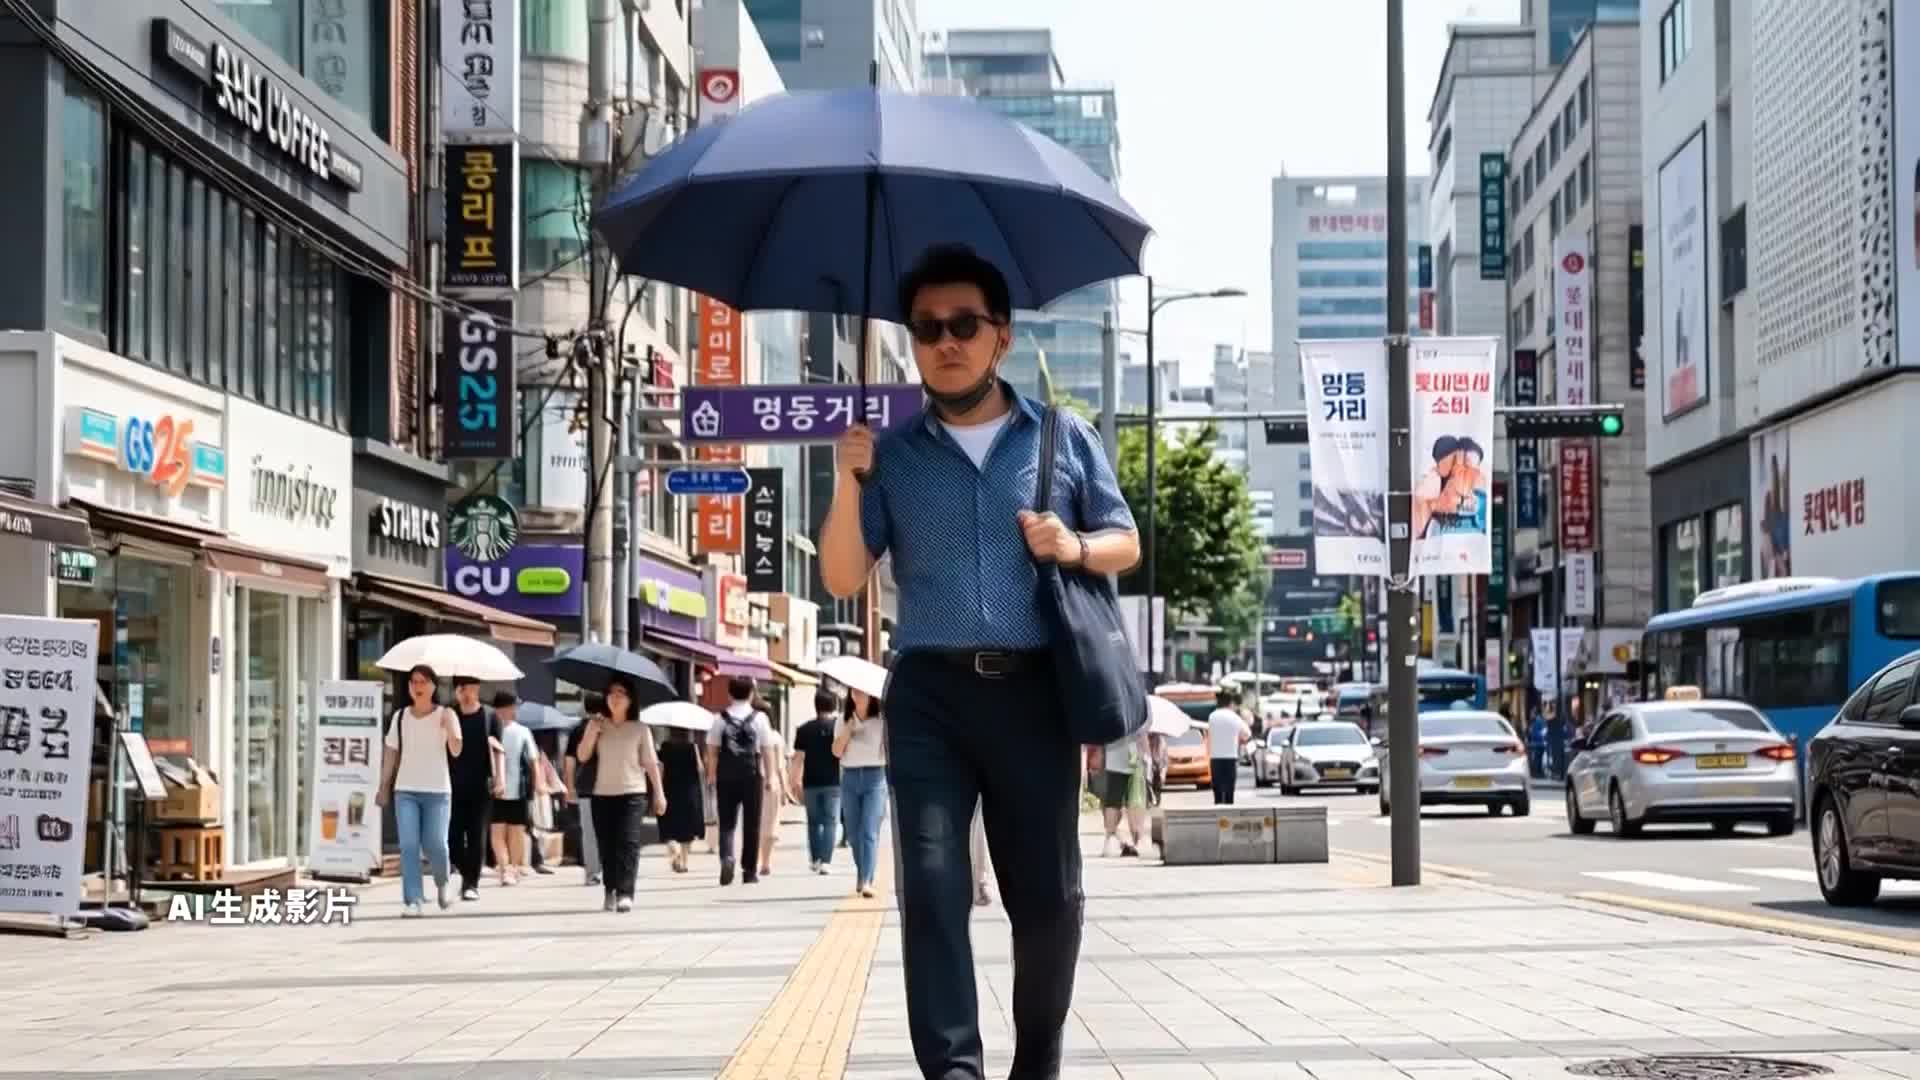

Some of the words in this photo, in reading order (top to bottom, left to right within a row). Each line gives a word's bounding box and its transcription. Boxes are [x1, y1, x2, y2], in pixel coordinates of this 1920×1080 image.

[266, 84, 330, 180] COFFEE
[459, 313, 498, 431] GS25
[752, 395, 890, 432] 명동거리
[1323, 398, 1367, 421] 거리
[125, 415, 194, 497] GS25
[455, 565, 510, 595] CU
